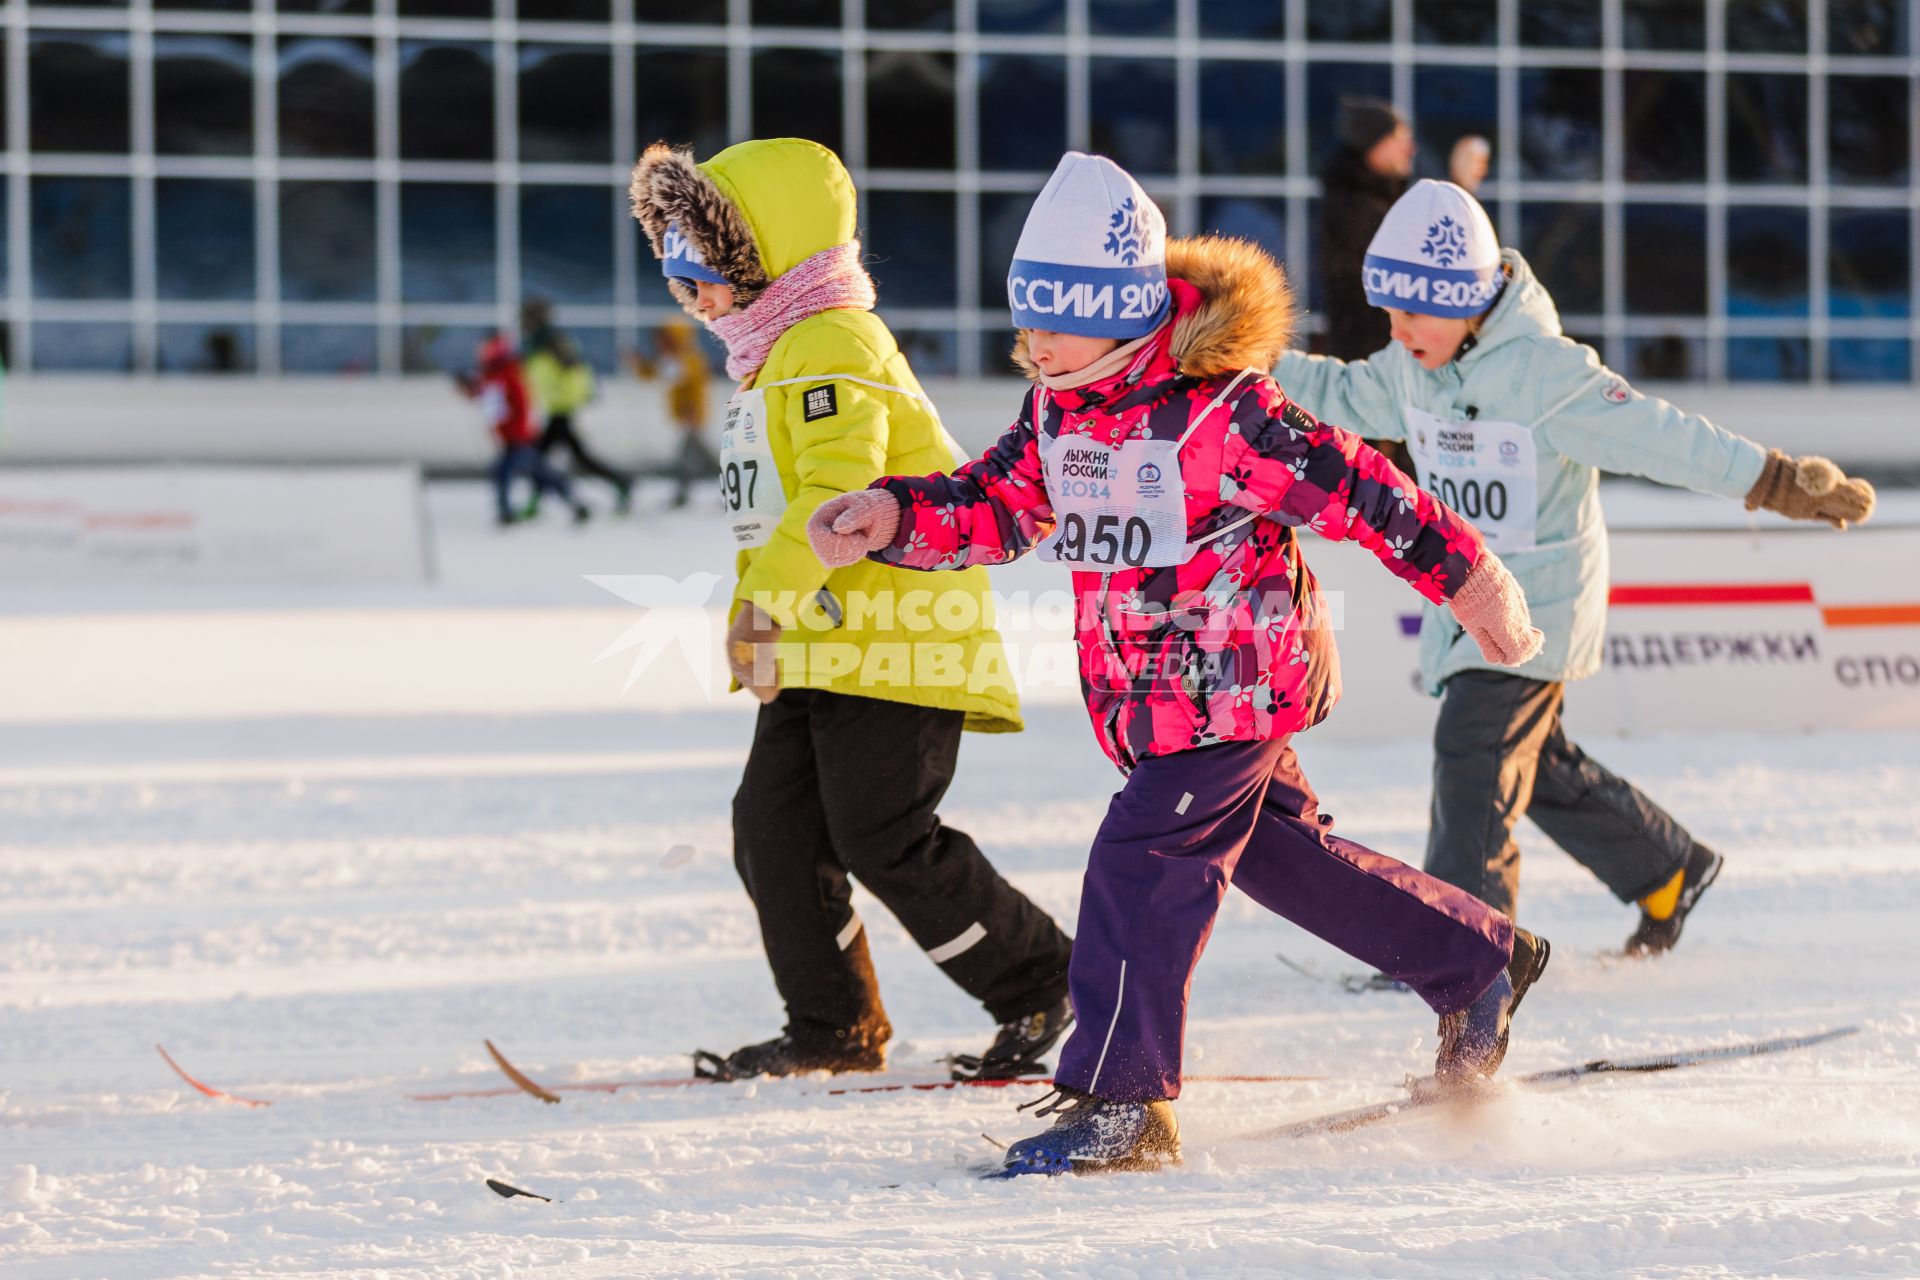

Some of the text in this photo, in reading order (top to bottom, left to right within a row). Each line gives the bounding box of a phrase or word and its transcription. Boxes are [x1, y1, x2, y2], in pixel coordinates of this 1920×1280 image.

[1363, 266, 1428, 302] СИИ
[1007, 277, 1113, 319] ССИИ
[808, 389, 830, 402] GIRL
[809, 397, 831, 411] REAL
[1063, 449, 1110, 466] ЛЫЖНЯ
[1062, 463, 1108, 480] РОССИИ
[1061, 479, 1112, 499] 2024
[1601, 633, 1820, 668] ДДЕРЖКИ
